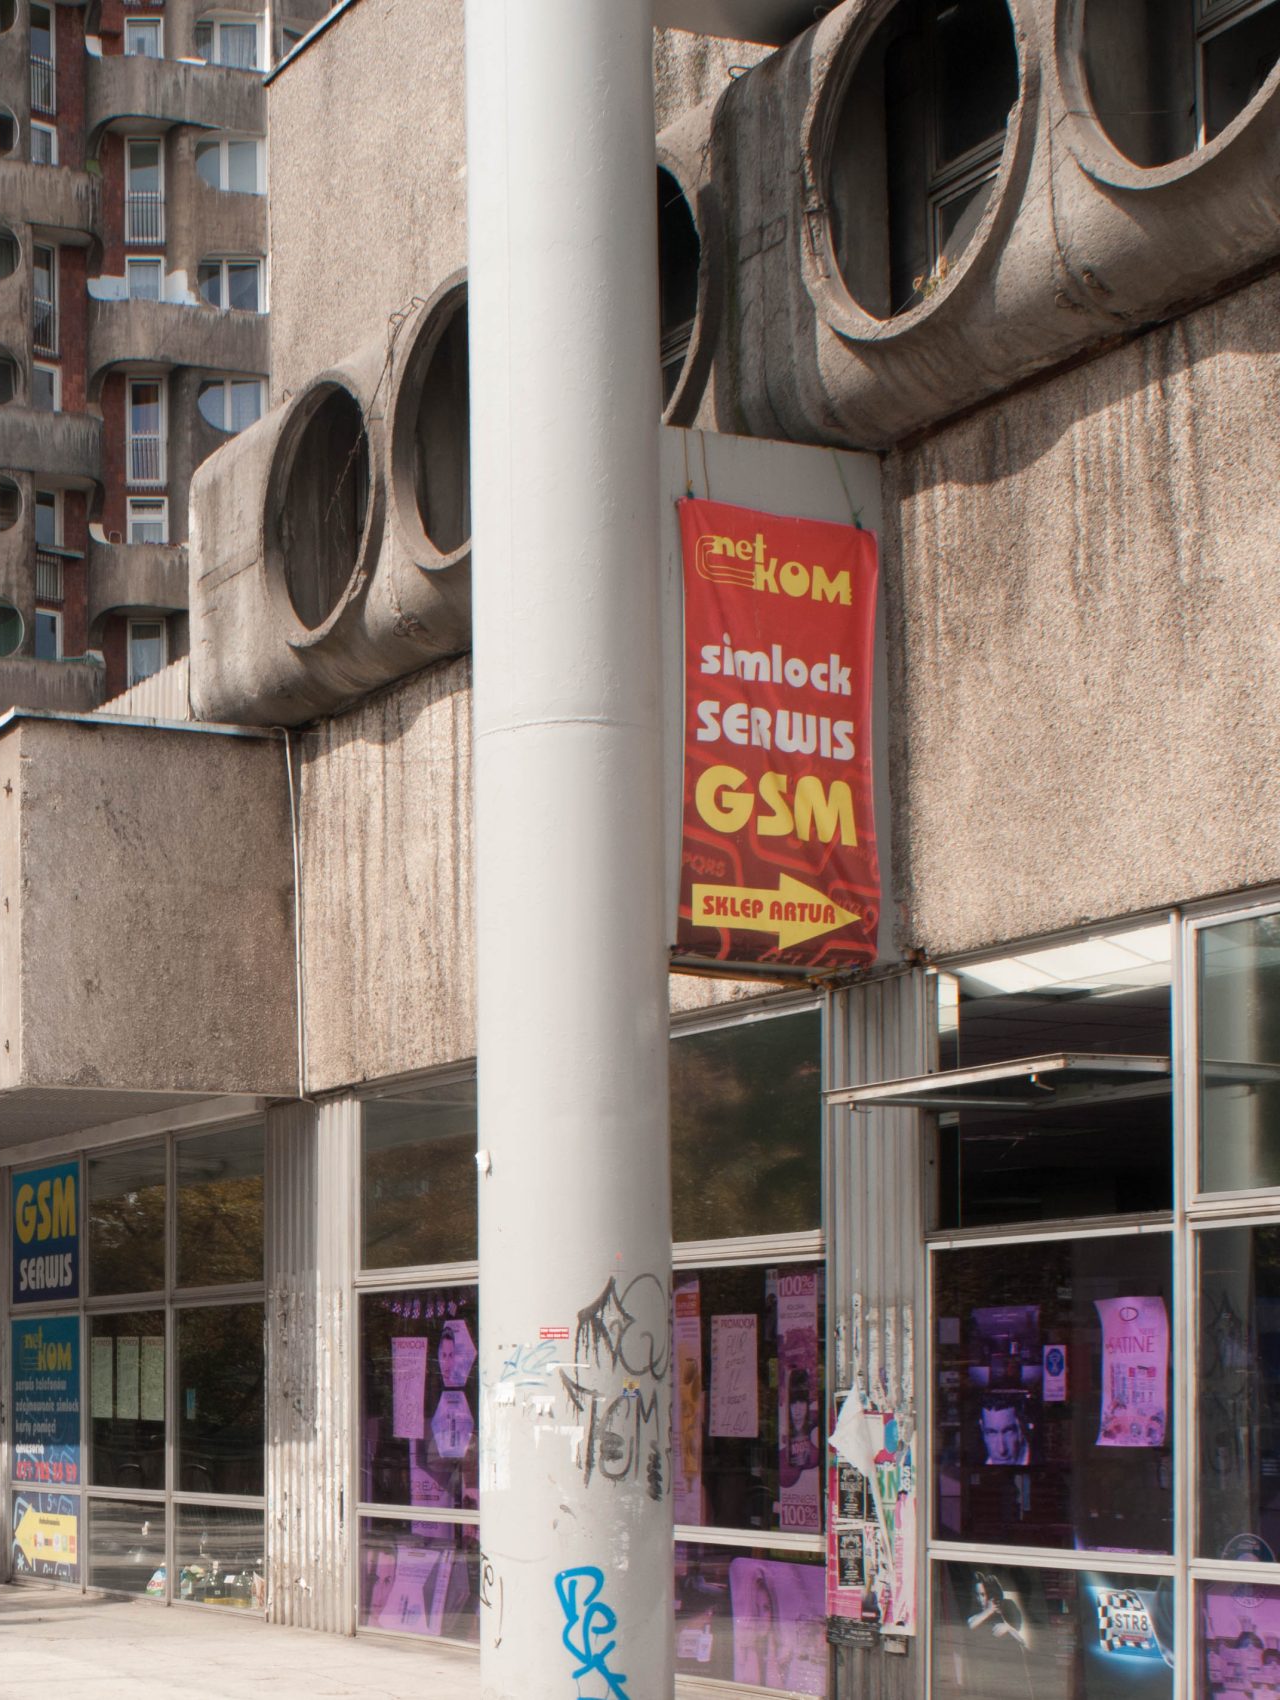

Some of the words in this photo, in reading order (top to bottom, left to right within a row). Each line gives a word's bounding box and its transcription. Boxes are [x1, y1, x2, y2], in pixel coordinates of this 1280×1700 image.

[753, 558, 853, 606] KOM
[700, 633, 852, 696] simlock
[696, 699, 856, 760] SERWIS
[695, 765, 858, 848] GSM
[702, 895, 763, 919] SKLEP
[769, 900, 836, 925] ARTUR
[16, 1175, 76, 1244] GSM
[20, 1253, 73, 1290] SERWIS
[1115, 1613, 1148, 1631] STR8
